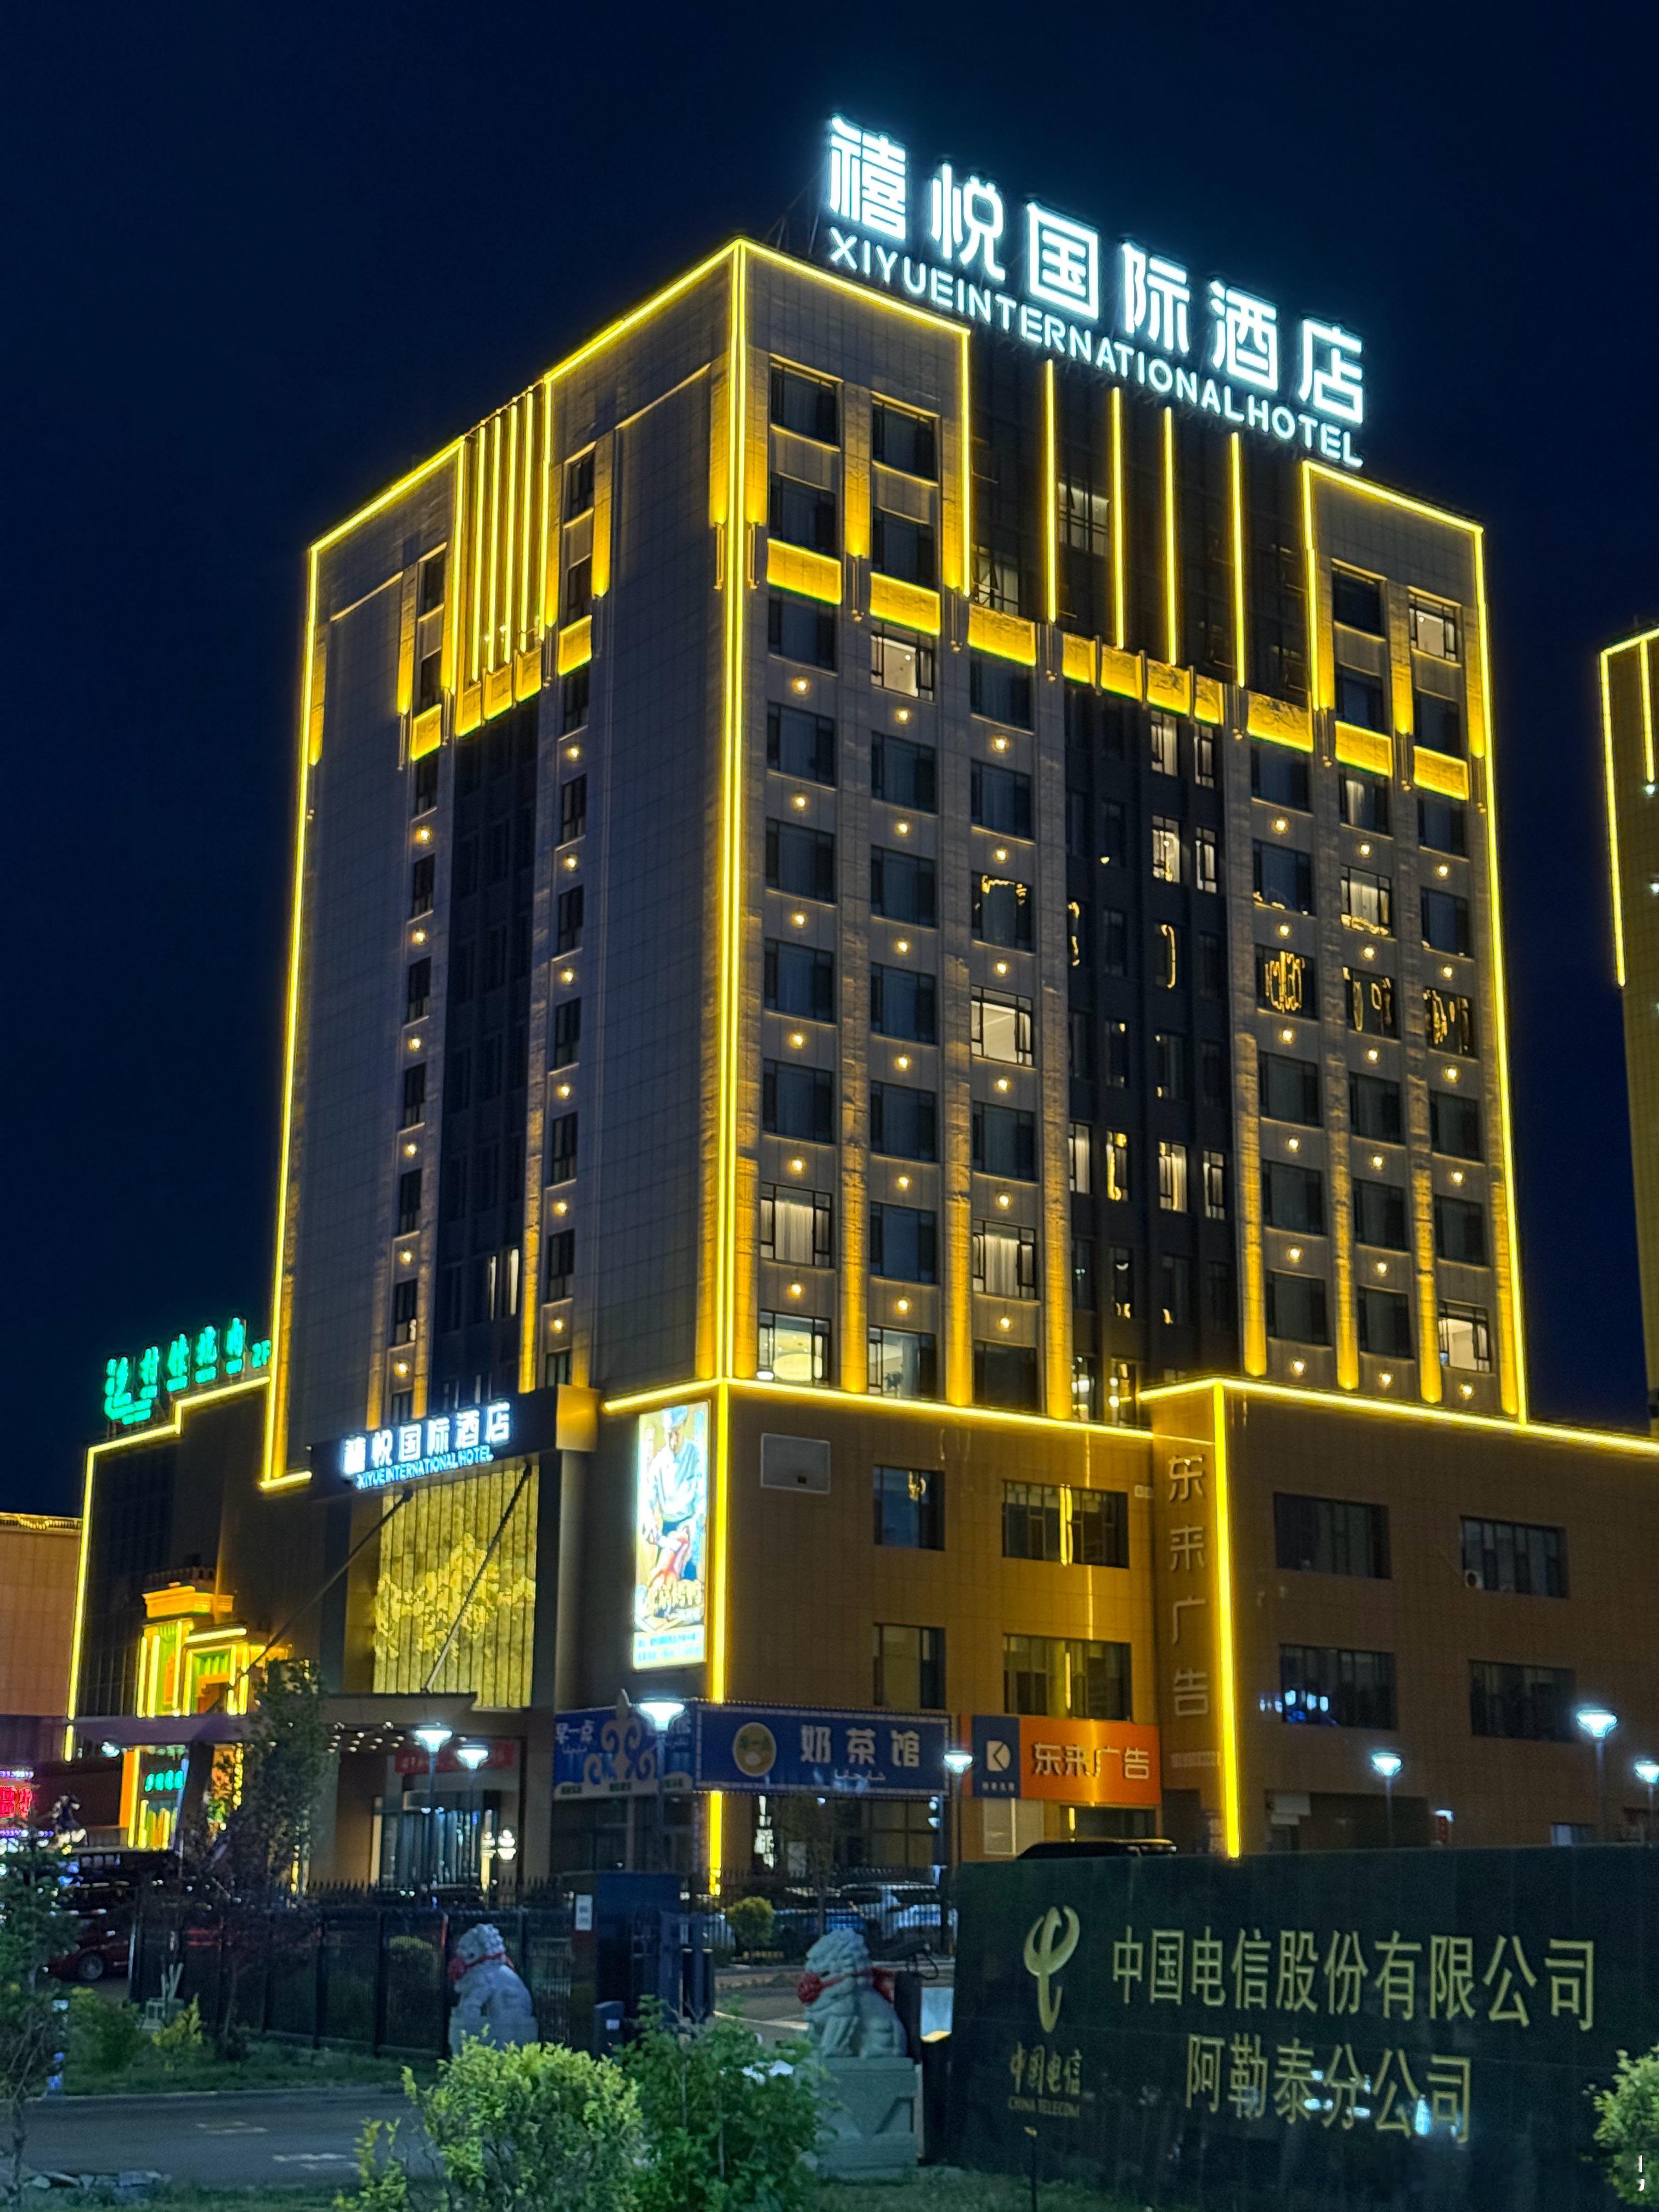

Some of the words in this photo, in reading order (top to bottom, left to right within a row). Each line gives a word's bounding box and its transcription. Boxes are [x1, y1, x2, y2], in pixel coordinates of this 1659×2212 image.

[828, 115, 1364, 425] 禧悦国际酒店
[1168, 1454, 1208, 1717] 东来广告
[800, 1724, 920, 1768] 奶茶馆
[1035, 1742, 1149, 1779] 东来广告
[1112, 1925, 1595, 2032] 中国电信股份有限公司
[1186, 2033, 1471, 2143] 阿勒泰分公司
